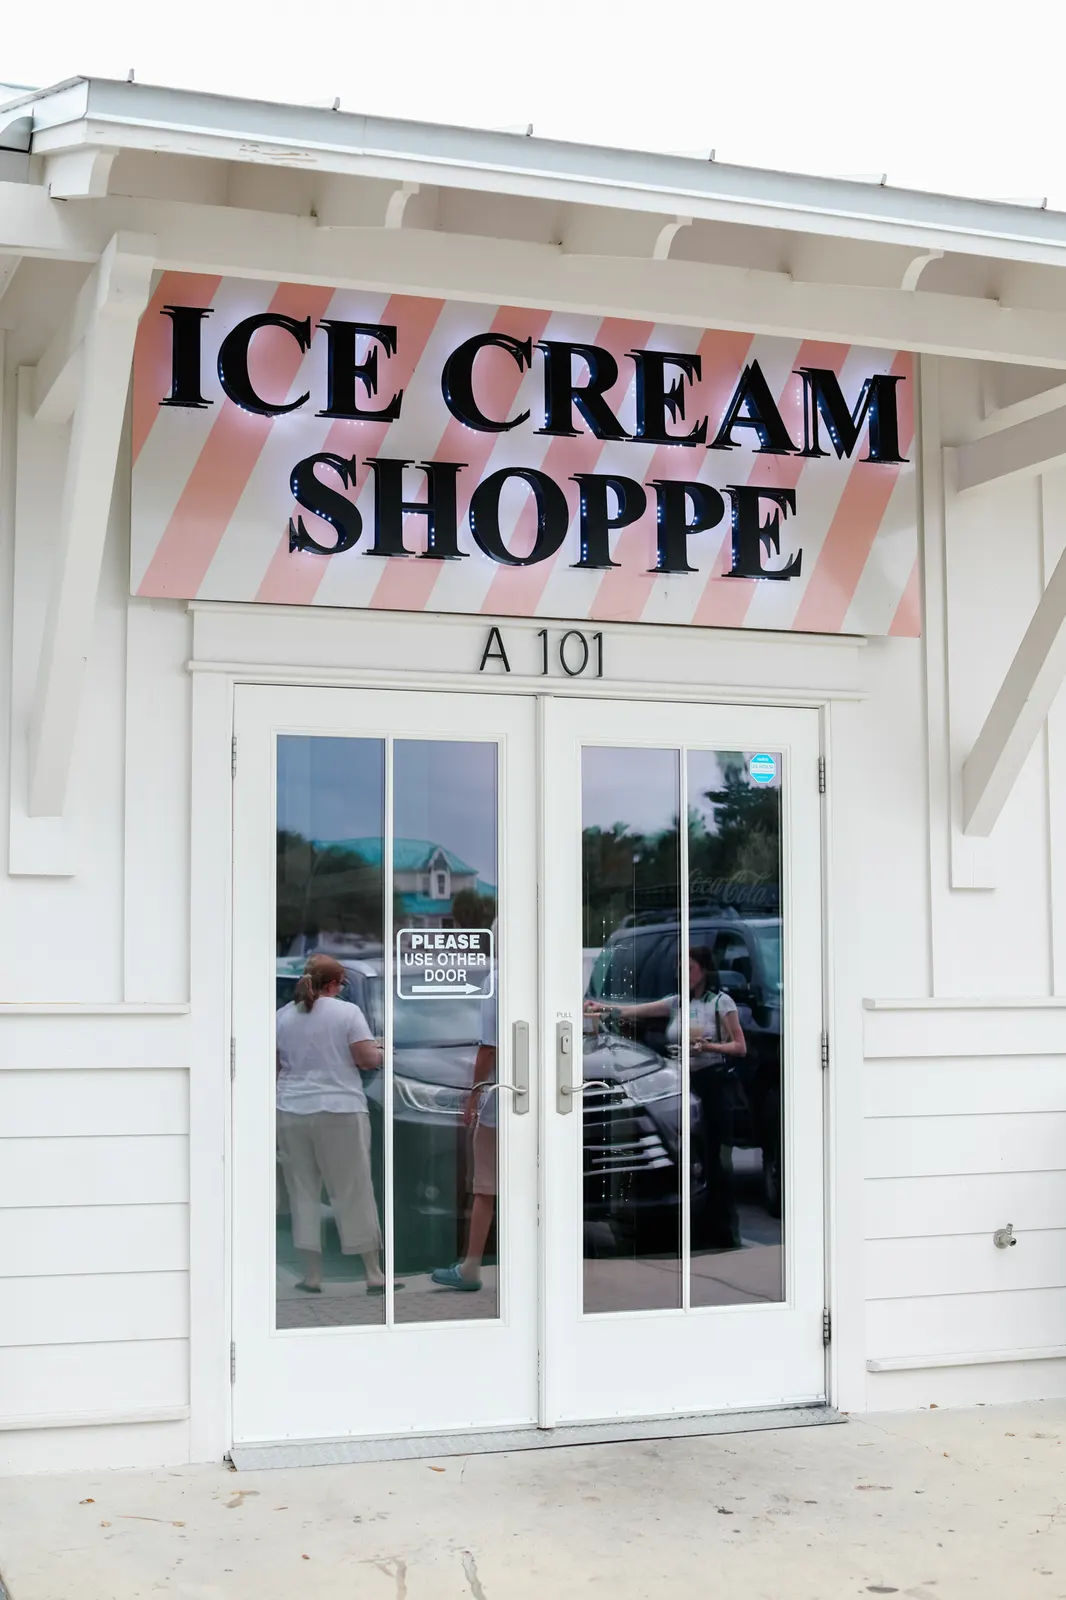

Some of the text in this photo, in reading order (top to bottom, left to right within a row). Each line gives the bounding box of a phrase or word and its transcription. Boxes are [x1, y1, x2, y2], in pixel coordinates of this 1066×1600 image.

[158, 305, 910, 464] ICE CREAM
[289, 452, 803, 581] SHOPPE
[479, 627, 603, 677] A 101
[411, 934, 481, 949] PLEASE
[404, 952, 486, 966] USE OTHER
[424, 969, 467, 982] DOOR
[556, 1011, 573, 1019] PULL
